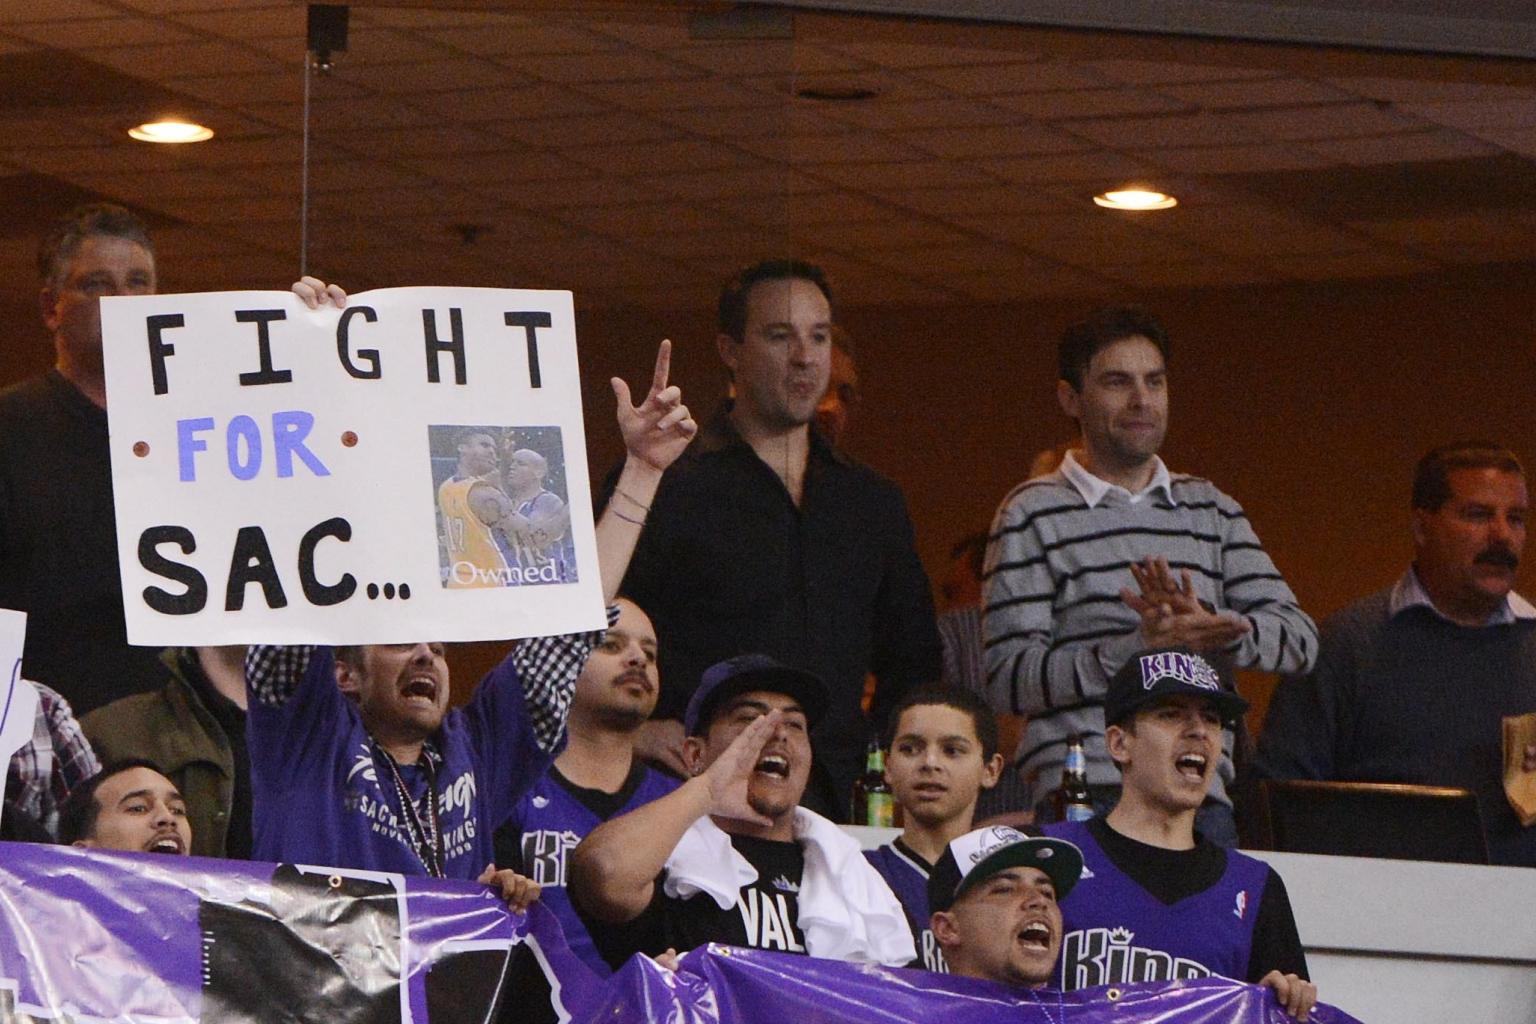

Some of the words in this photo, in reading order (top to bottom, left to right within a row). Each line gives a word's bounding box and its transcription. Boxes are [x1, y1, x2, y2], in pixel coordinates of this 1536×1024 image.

[146, 305, 552, 395] FIGHT
[177, 411, 331, 482] FOR
[137, 517, 411, 615] SAC...
[1062, 926, 1249, 993] Kin
